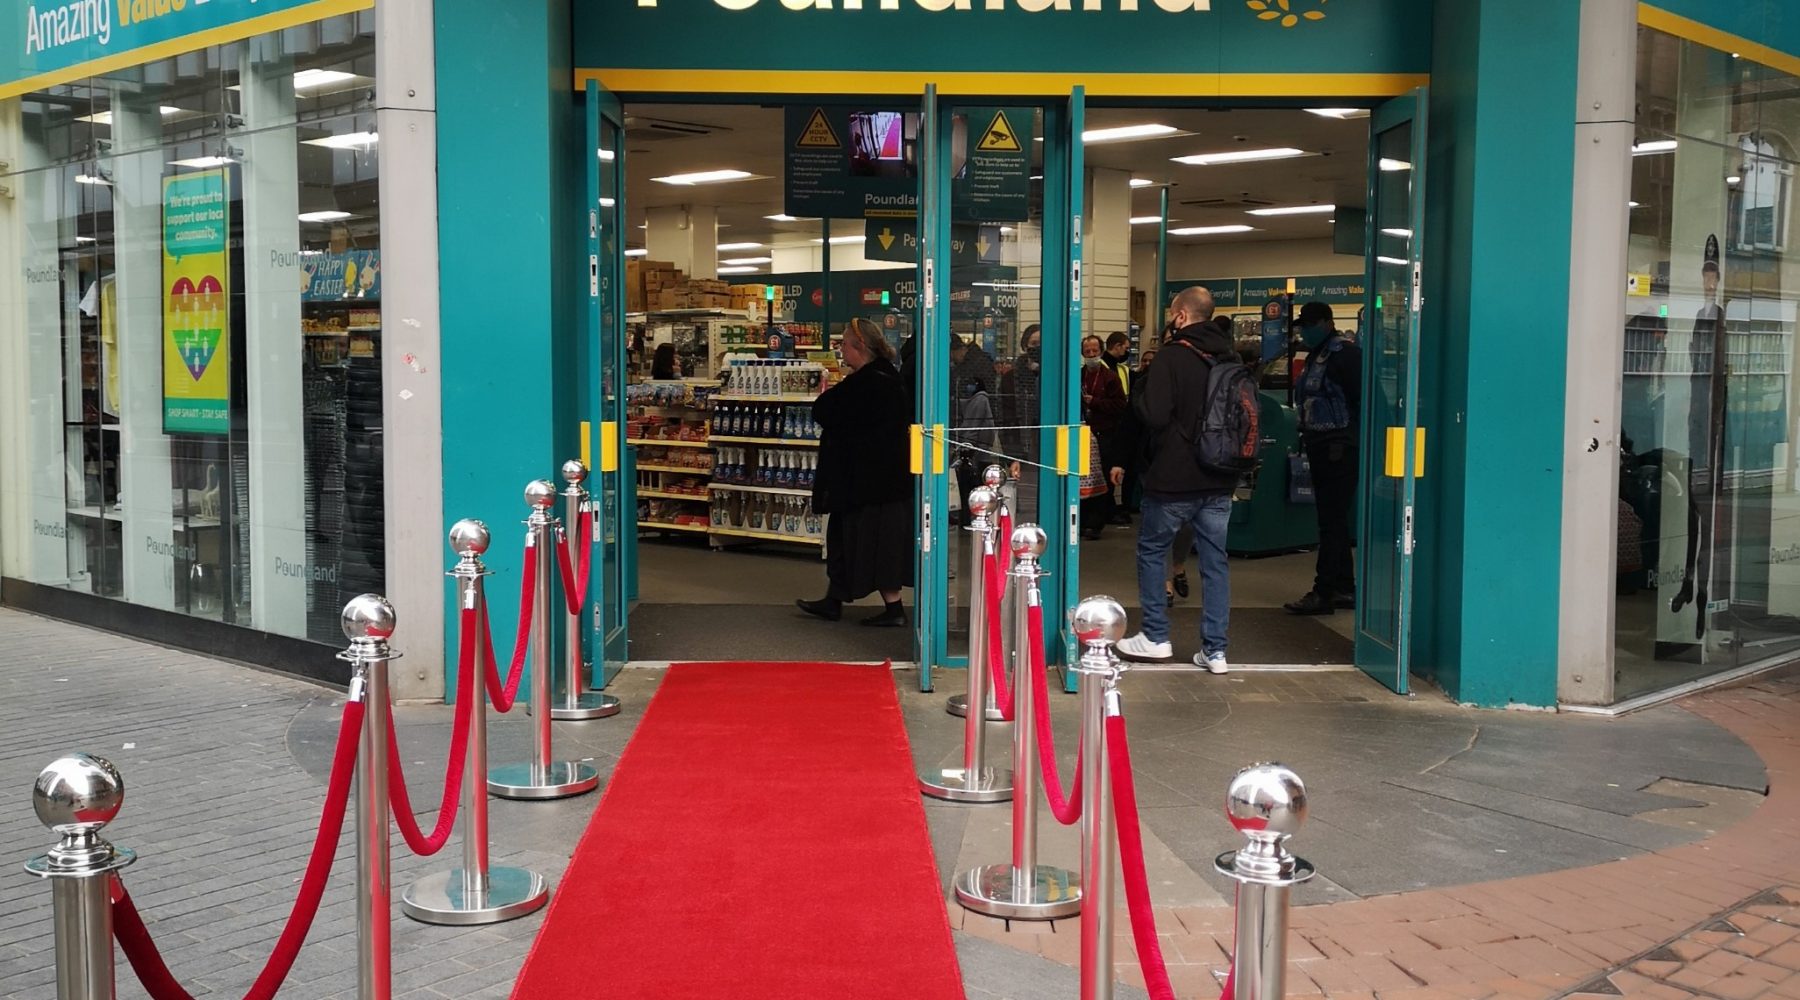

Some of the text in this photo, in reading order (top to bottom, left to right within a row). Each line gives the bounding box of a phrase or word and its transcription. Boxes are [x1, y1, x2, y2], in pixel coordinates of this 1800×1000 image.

[26, 0, 110, 55] Amazing
[865, 193, 918, 205] Poundla
[208, 208, 224, 220] loca
[903, 233, 917, 248] Pa
[318, 260, 344, 276] HAPPY
[313, 279, 345, 297] EASTER
[783, 285, 803, 297] LLED
[895, 281, 917, 294] CHIL
[993, 279, 1018, 292] CHILLE
[1321, 285, 1365, 296] Amazing Valu
[1243, 288, 1268, 298] Amazing
[901, 297, 917, 309] FO
[997, 295, 1018, 308] FOOD
[146, 536, 197, 561] Poundland
[1771, 543, 1800, 565] Poundla
[275, 556, 336, 582] Pounand
[1647, 564, 1686, 588] Poundla
